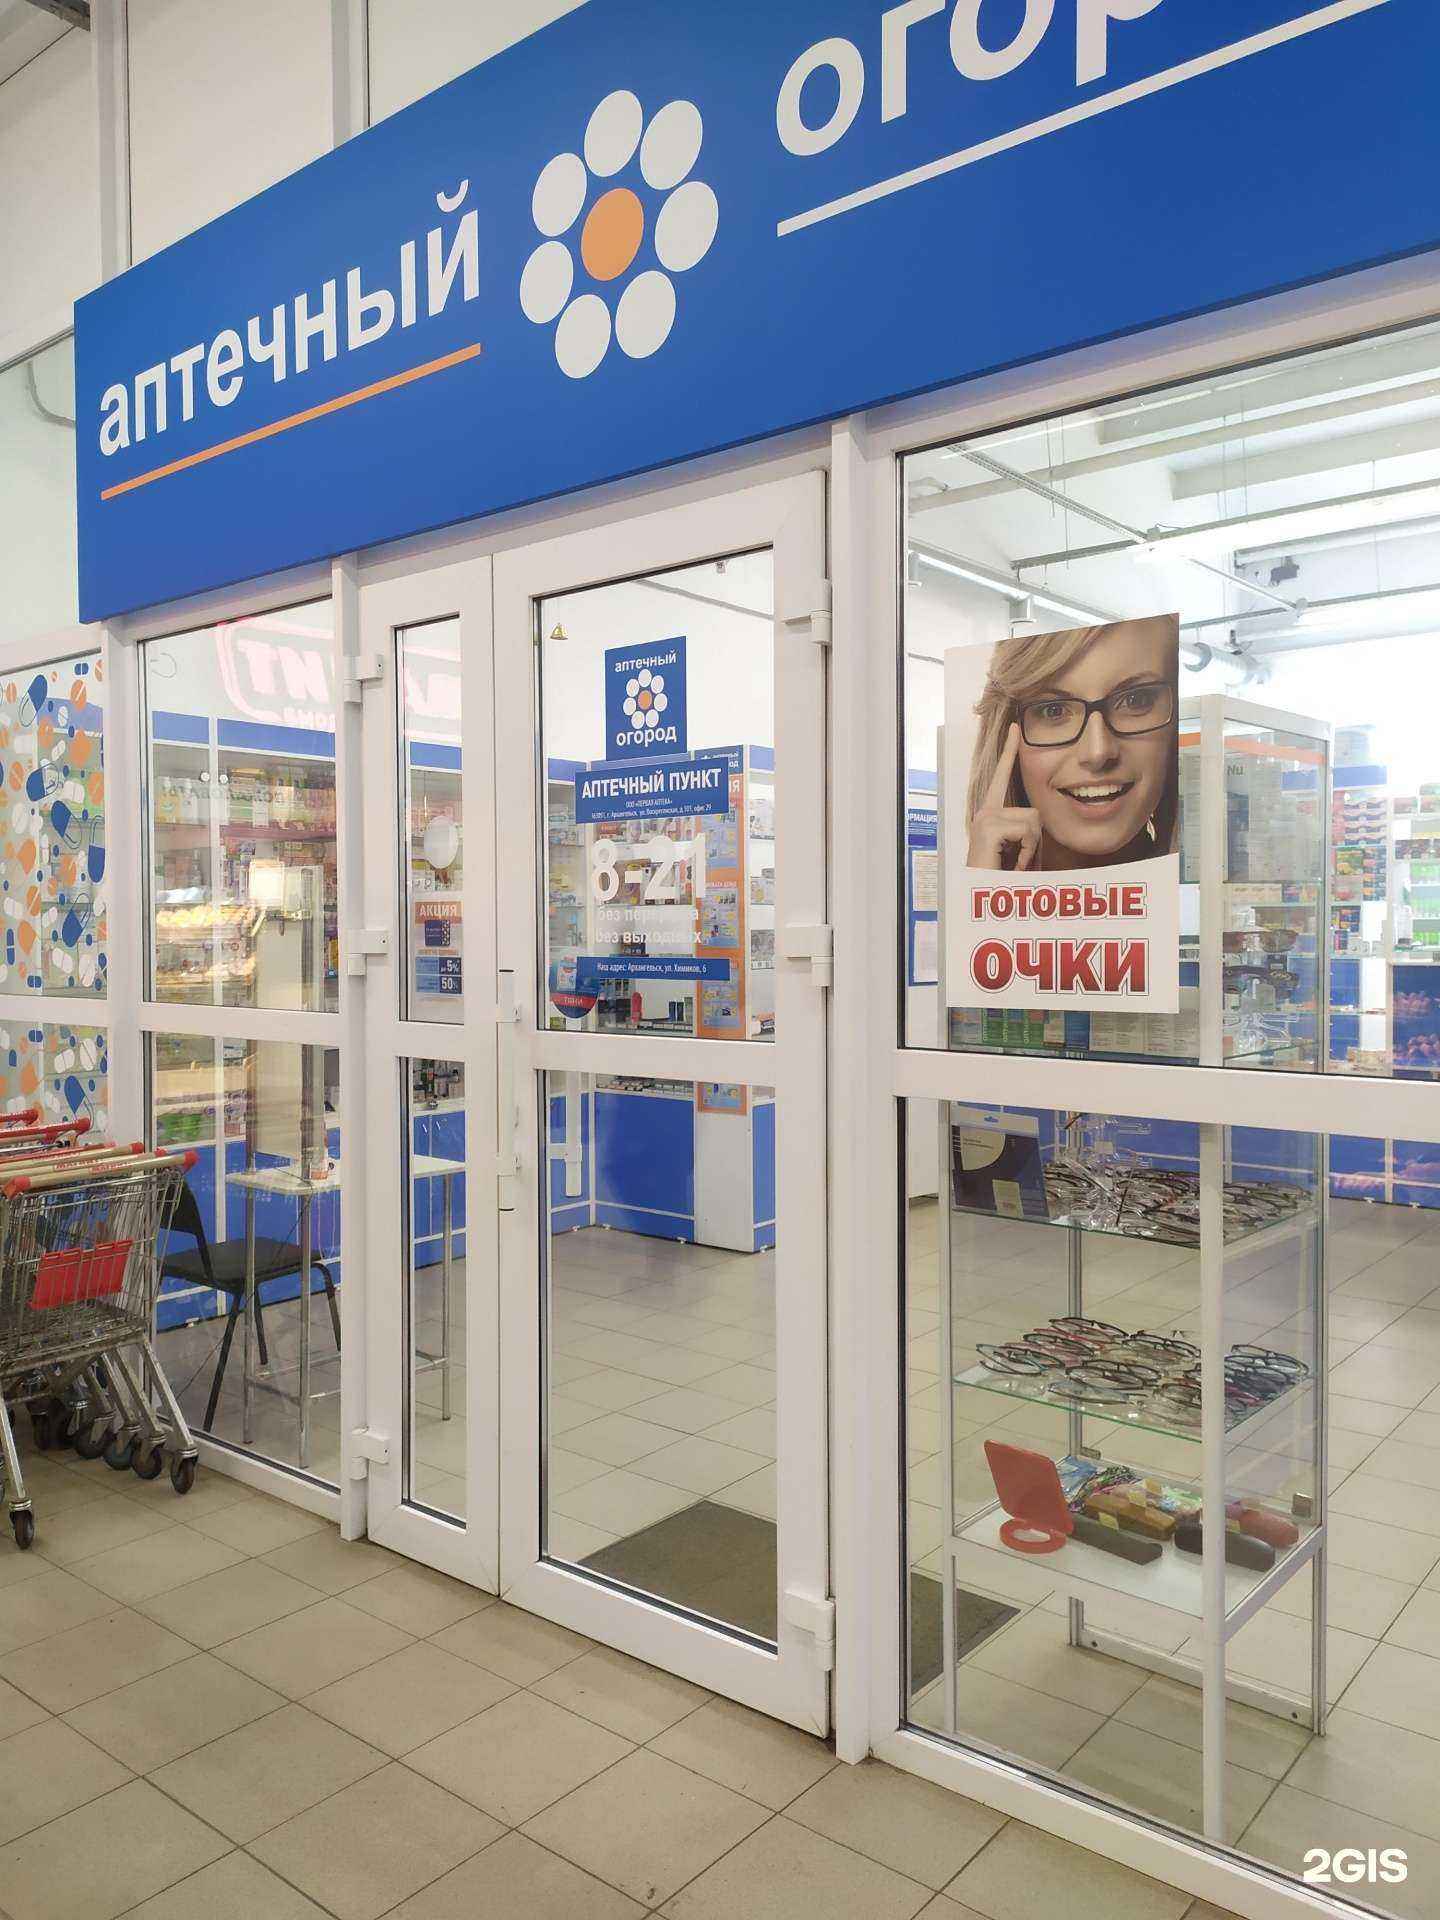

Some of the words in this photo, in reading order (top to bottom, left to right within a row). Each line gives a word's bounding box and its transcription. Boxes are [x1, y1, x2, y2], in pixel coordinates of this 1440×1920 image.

[99, 179, 480, 456] аптечный
[615, 649, 677, 672] аптечный
[616, 726, 677, 747] огород
[582, 769, 664, 799] АПТЕЧНЫЙ
[669, 768, 722, 791] ПУНКТ
[591, 832, 706, 904] 8-21
[419, 903, 458, 919] АКЦИЯ
[972, 883, 1146, 920] ГОТОВЫЕ
[971, 939, 1148, 995] ОЧКИ
